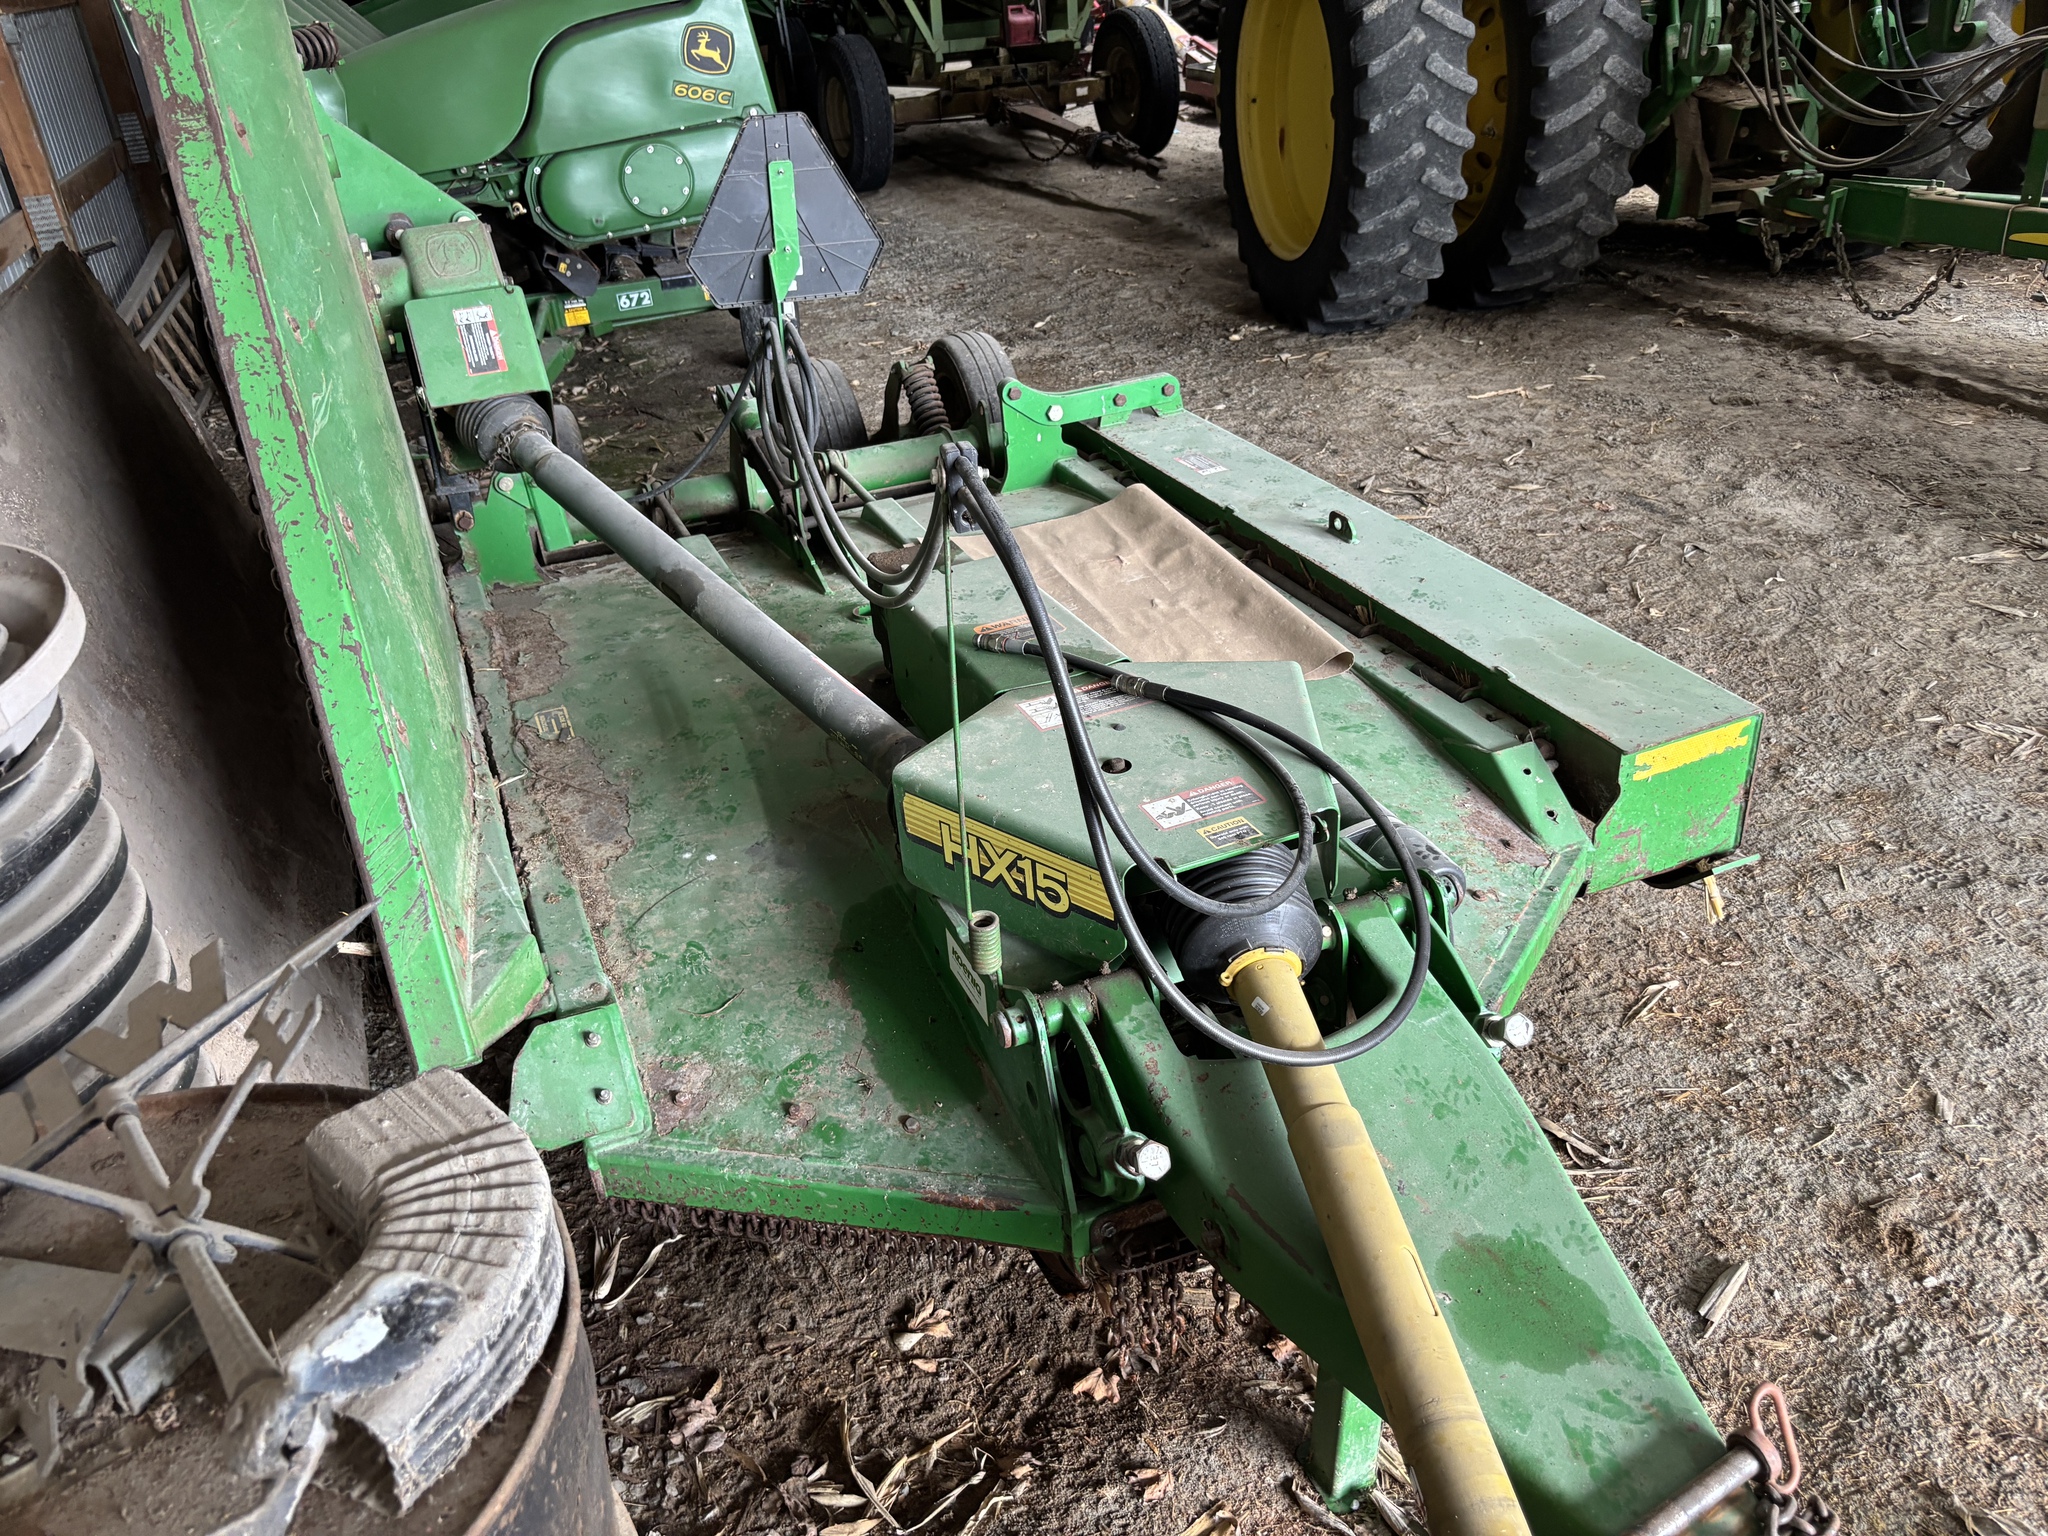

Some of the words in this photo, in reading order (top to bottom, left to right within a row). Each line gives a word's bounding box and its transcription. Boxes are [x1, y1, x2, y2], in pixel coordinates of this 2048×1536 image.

[674, 83, 732, 105] 606C
[620, 291, 651, 309] 672
[1198, 780, 1234, 794] DANGER
[1211, 818, 1245, 832] CAUTION
[939, 820, 1071, 917] HX15
